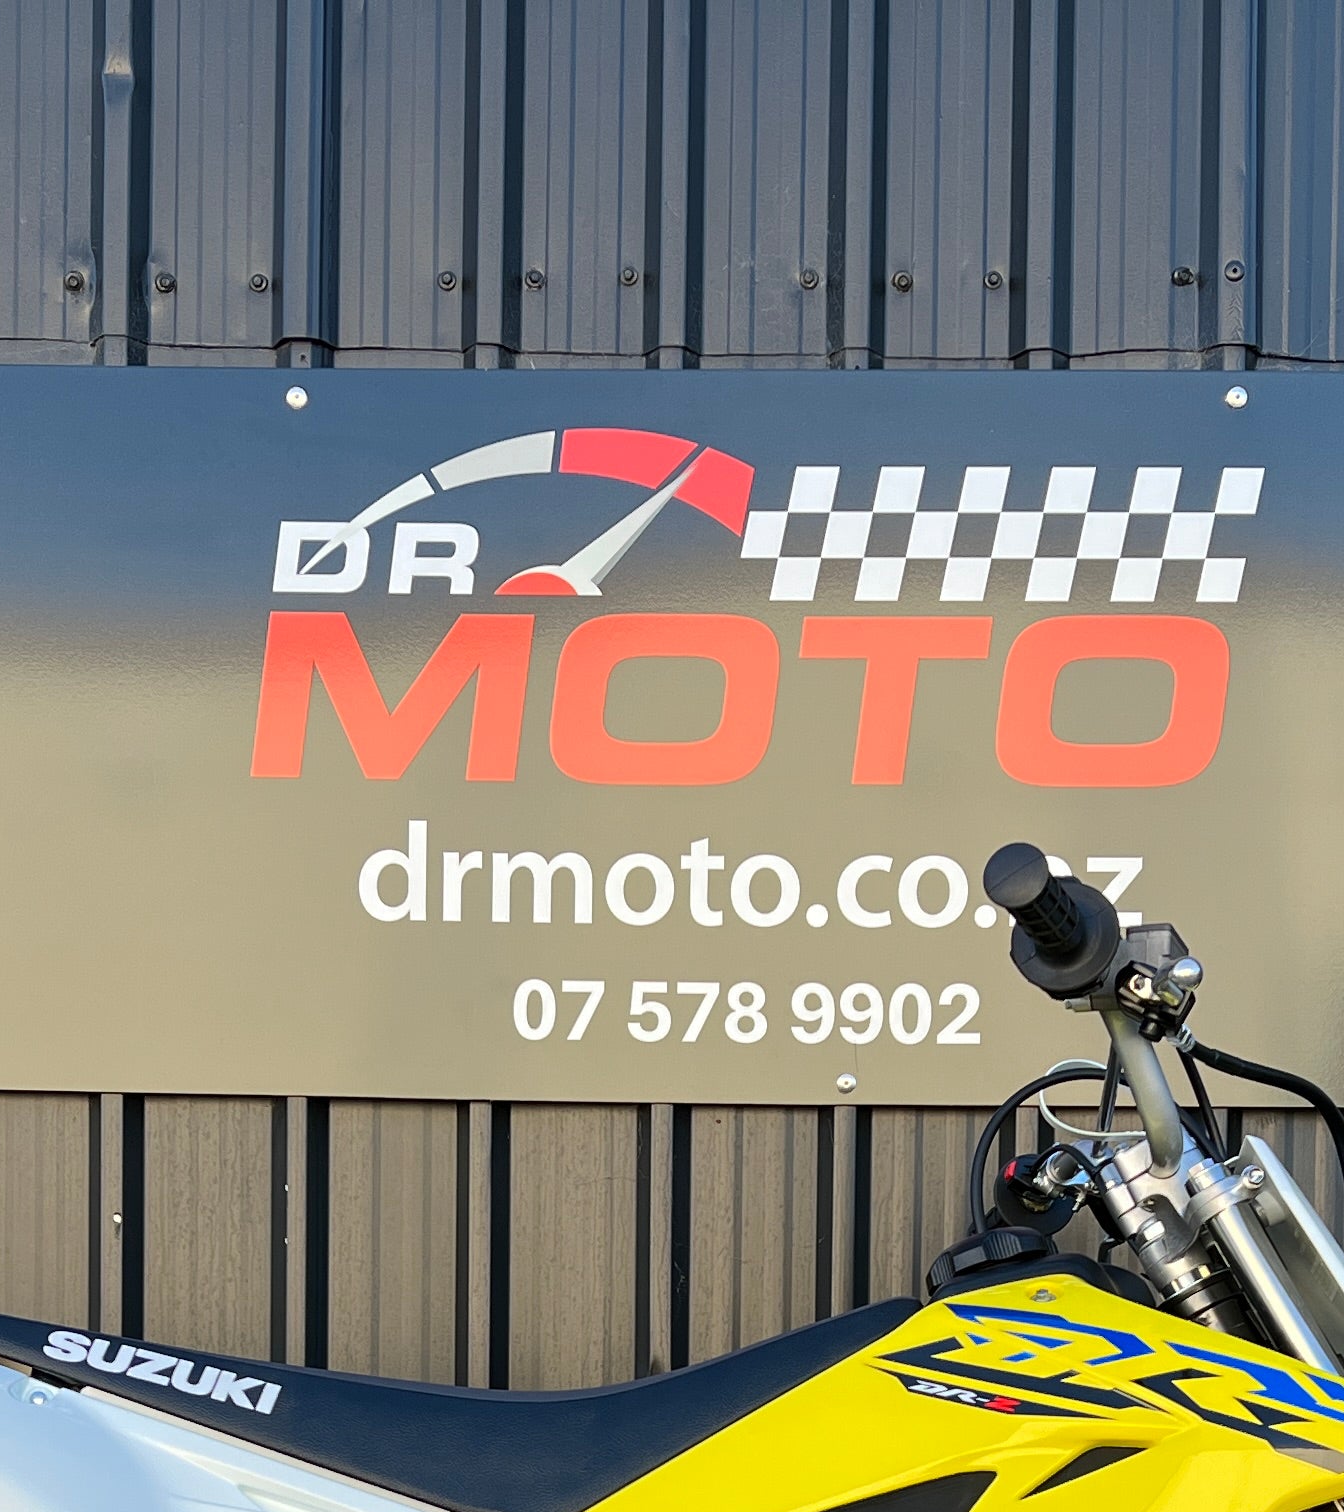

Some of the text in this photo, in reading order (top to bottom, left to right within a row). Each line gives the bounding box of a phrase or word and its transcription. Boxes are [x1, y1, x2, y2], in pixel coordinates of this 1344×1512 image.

[272, 520, 480, 595] DR
[250, 611, 1231, 787] MOTO
[358, 819, 1145, 928] drmoto.co.z
[512, 979, 982, 1046] 07 578 9902
[42, 1330, 283, 1415] SUZUKI
[907, 1379, 1022, 1414] DR-Z
